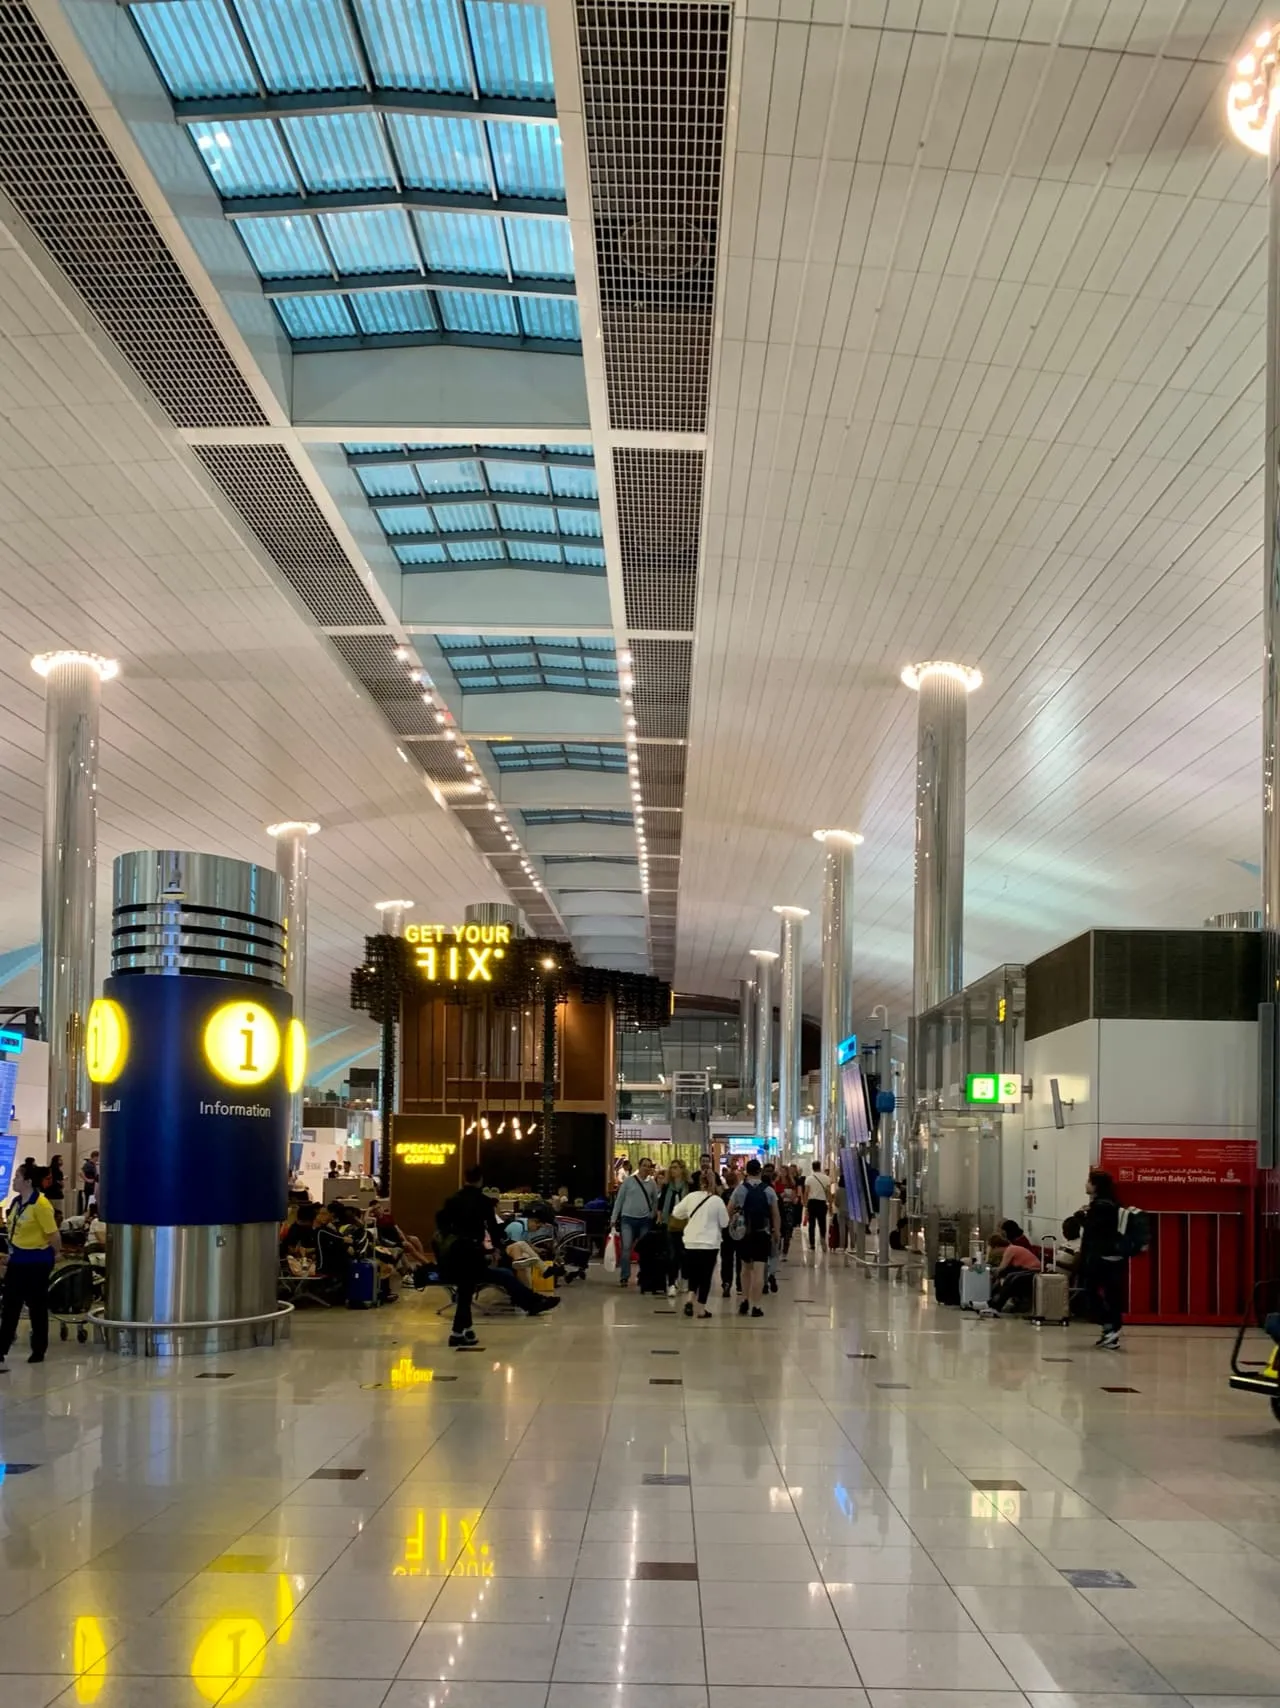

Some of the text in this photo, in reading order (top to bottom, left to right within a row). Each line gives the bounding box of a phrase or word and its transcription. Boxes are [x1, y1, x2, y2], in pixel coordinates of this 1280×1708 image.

[405, 925, 510, 944] GET YOUR
[200, 1100, 271, 1118] Information
[396, 1143, 456, 1155] SPECIALTY
[1137, 1174, 1167, 1183] Emirates
[1168, 1174, 1187, 1184] Baby
[1187, 1174, 1217, 1183] Strollers
